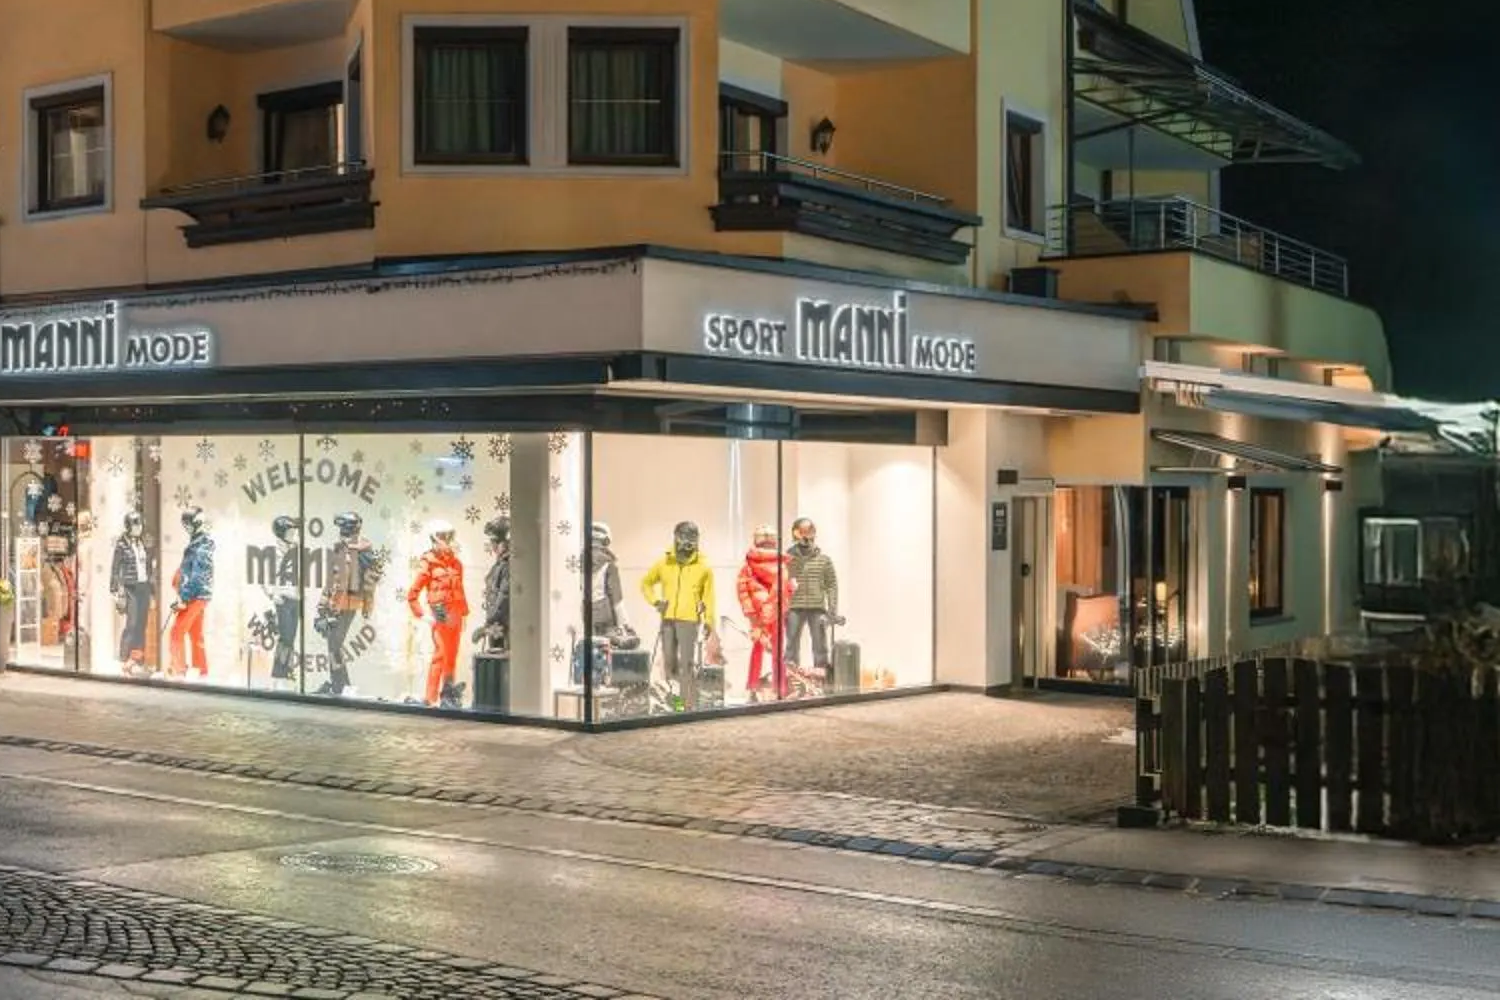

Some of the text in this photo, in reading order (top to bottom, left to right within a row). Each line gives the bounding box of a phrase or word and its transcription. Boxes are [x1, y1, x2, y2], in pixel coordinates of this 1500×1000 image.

[125, 333, 209, 366] MODE
[707, 315, 786, 354] SPORT
[913, 336, 975, 372] MODE
[241, 458, 381, 505] WELCOME
